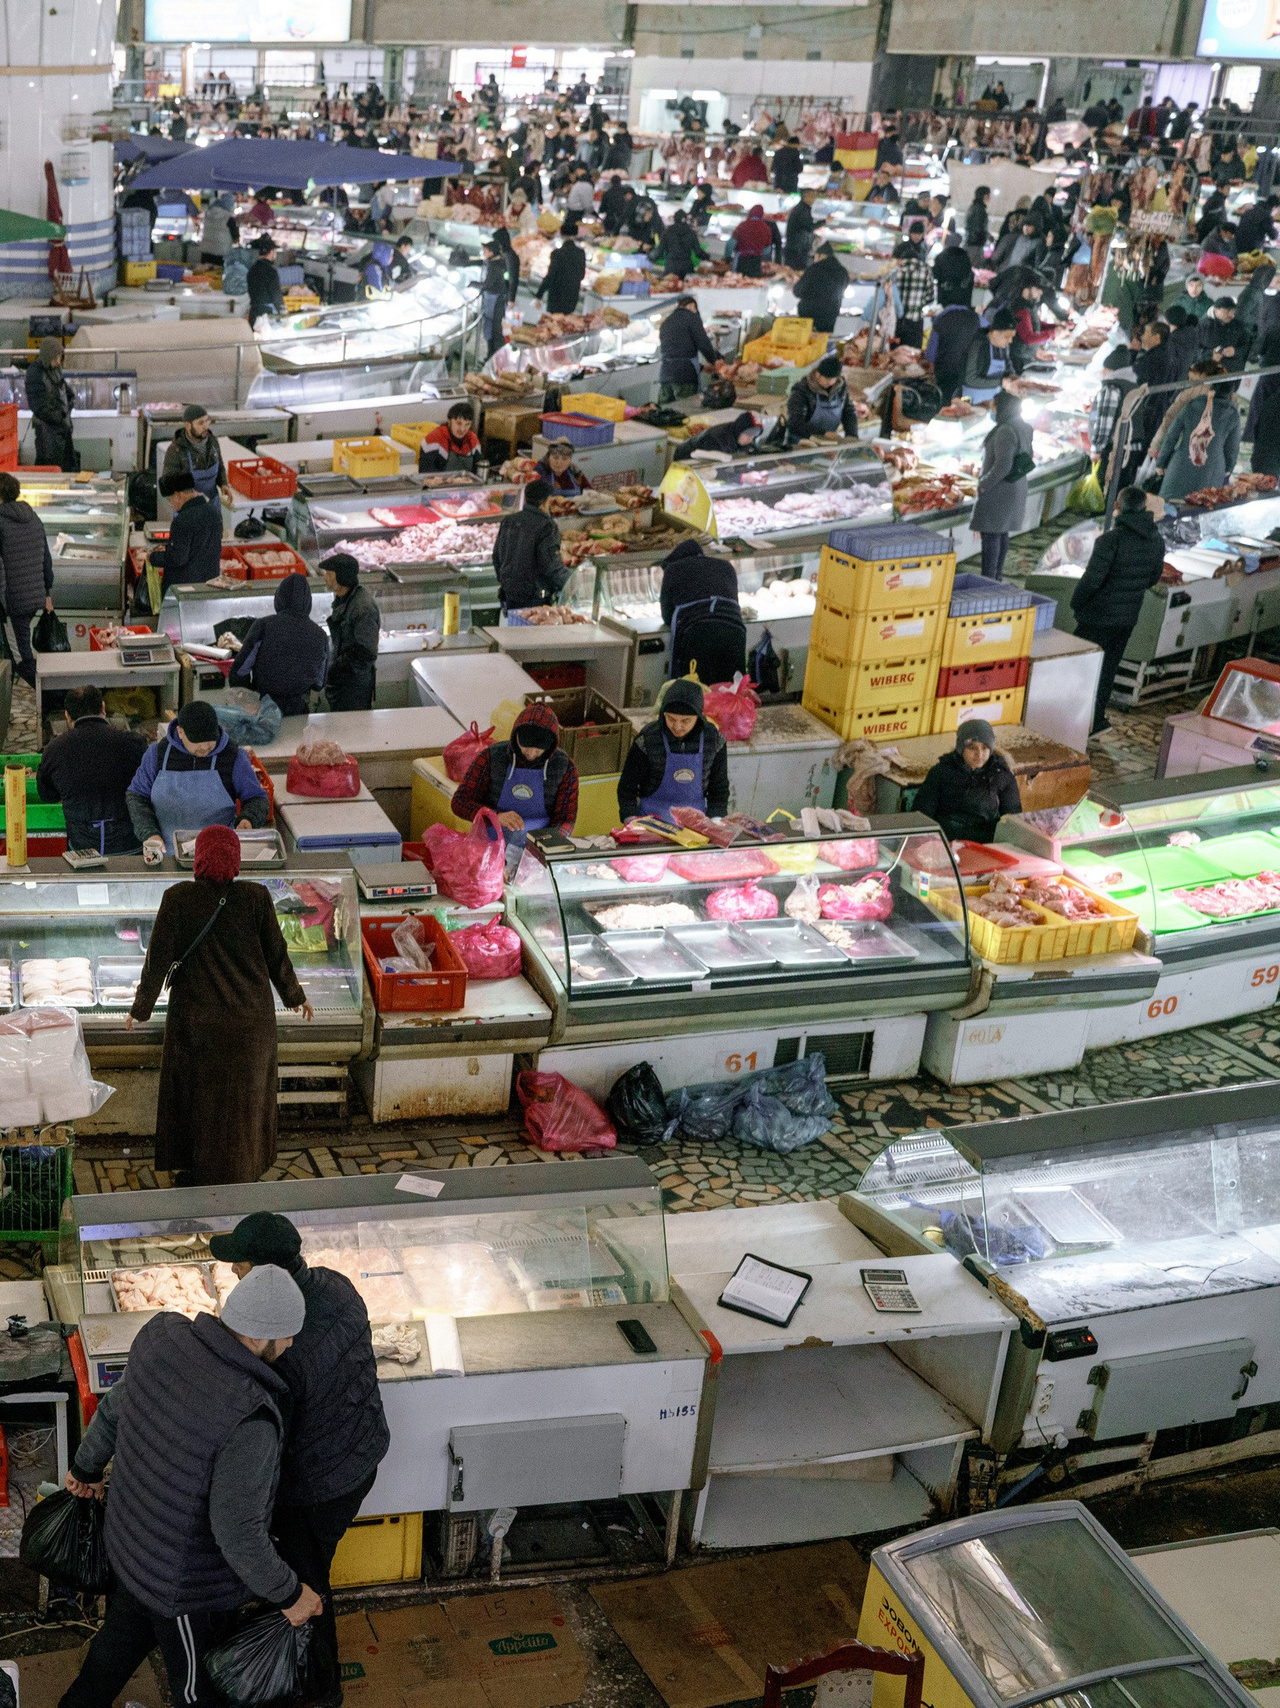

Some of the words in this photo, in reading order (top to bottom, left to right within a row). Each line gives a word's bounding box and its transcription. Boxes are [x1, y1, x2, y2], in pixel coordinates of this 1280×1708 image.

[870, 672, 915, 688] WIBERG
[863, 720, 908, 736] WIBERG
[1251, 965, 1280, 988] 59
[1147, 996, 1178, 1019] 60
[724, 1052, 758, 1073] 61
[483, 1597, 508, 1619] 15
[878, 1608, 912, 1656] EXPOR
